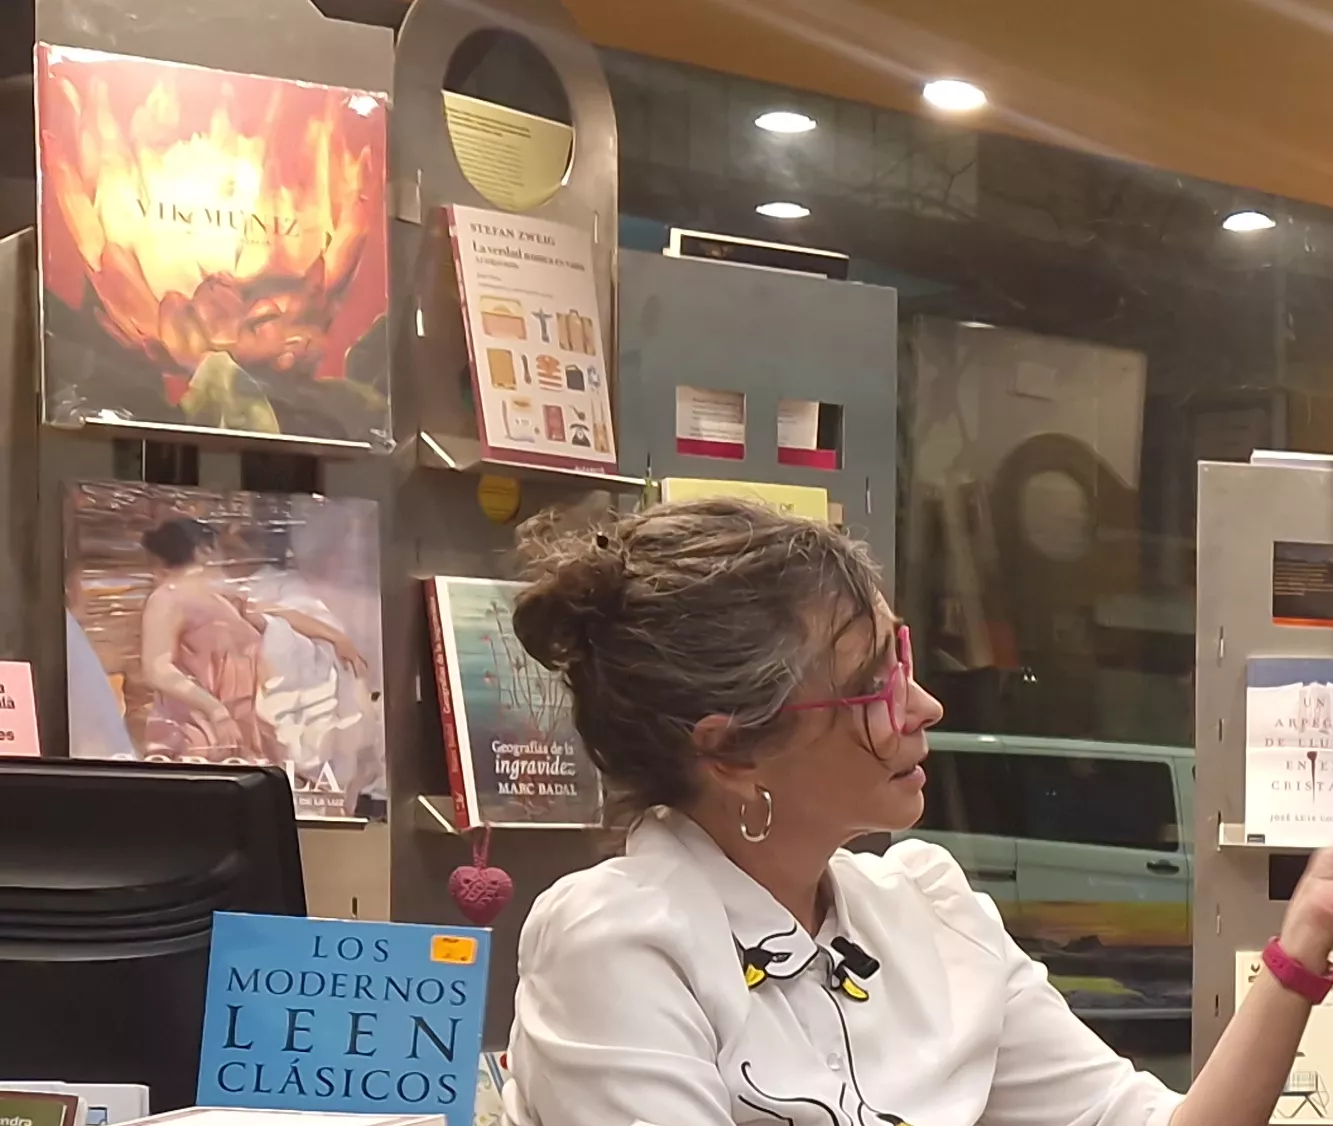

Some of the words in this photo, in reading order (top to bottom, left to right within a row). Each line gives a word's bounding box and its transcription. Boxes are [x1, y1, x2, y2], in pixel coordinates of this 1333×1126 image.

[469, 222, 515, 239] STEFAN
[1303, 697, 1325, 708] UN
[492, 740, 549, 757] Geografías
[550, 740, 563, 755] de
[564, 741, 574, 755] la
[1265, 737, 1285, 748] DE
[495, 754, 576, 781] ingravidez
[1286, 760, 1306, 770] EN
[498, 782, 536, 796] MARC
[537, 783, 578, 796] BADAL
[312, 934, 390, 963] LOS
[228, 966, 469, 1007] MODERNOS
[223, 1004, 463, 1063] LEEN
[217, 1058, 459, 1104] CLÁSICOS
